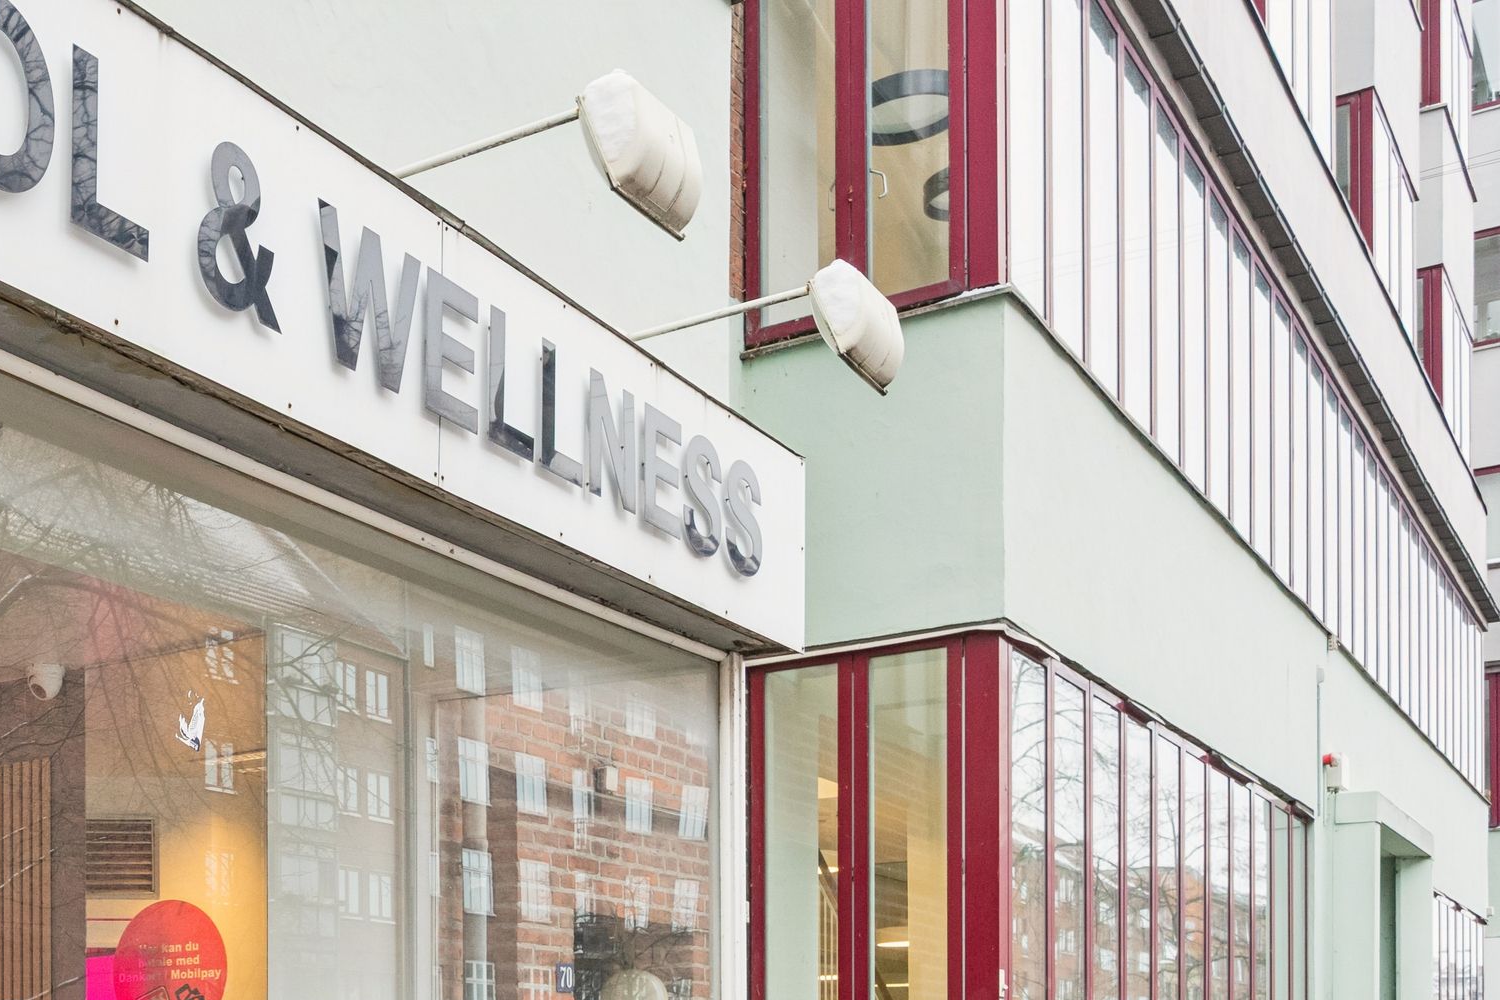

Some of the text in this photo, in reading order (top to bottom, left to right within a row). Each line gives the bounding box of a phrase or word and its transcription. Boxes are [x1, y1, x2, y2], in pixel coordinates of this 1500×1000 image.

[197, 141, 282, 334] &
[317, 197, 763, 578] WELLNESS
[162, 943, 182, 953] kan
[185, 941, 199, 951] du
[176, 955, 200, 966] med
[171, 967, 222, 981] Mobilpay
